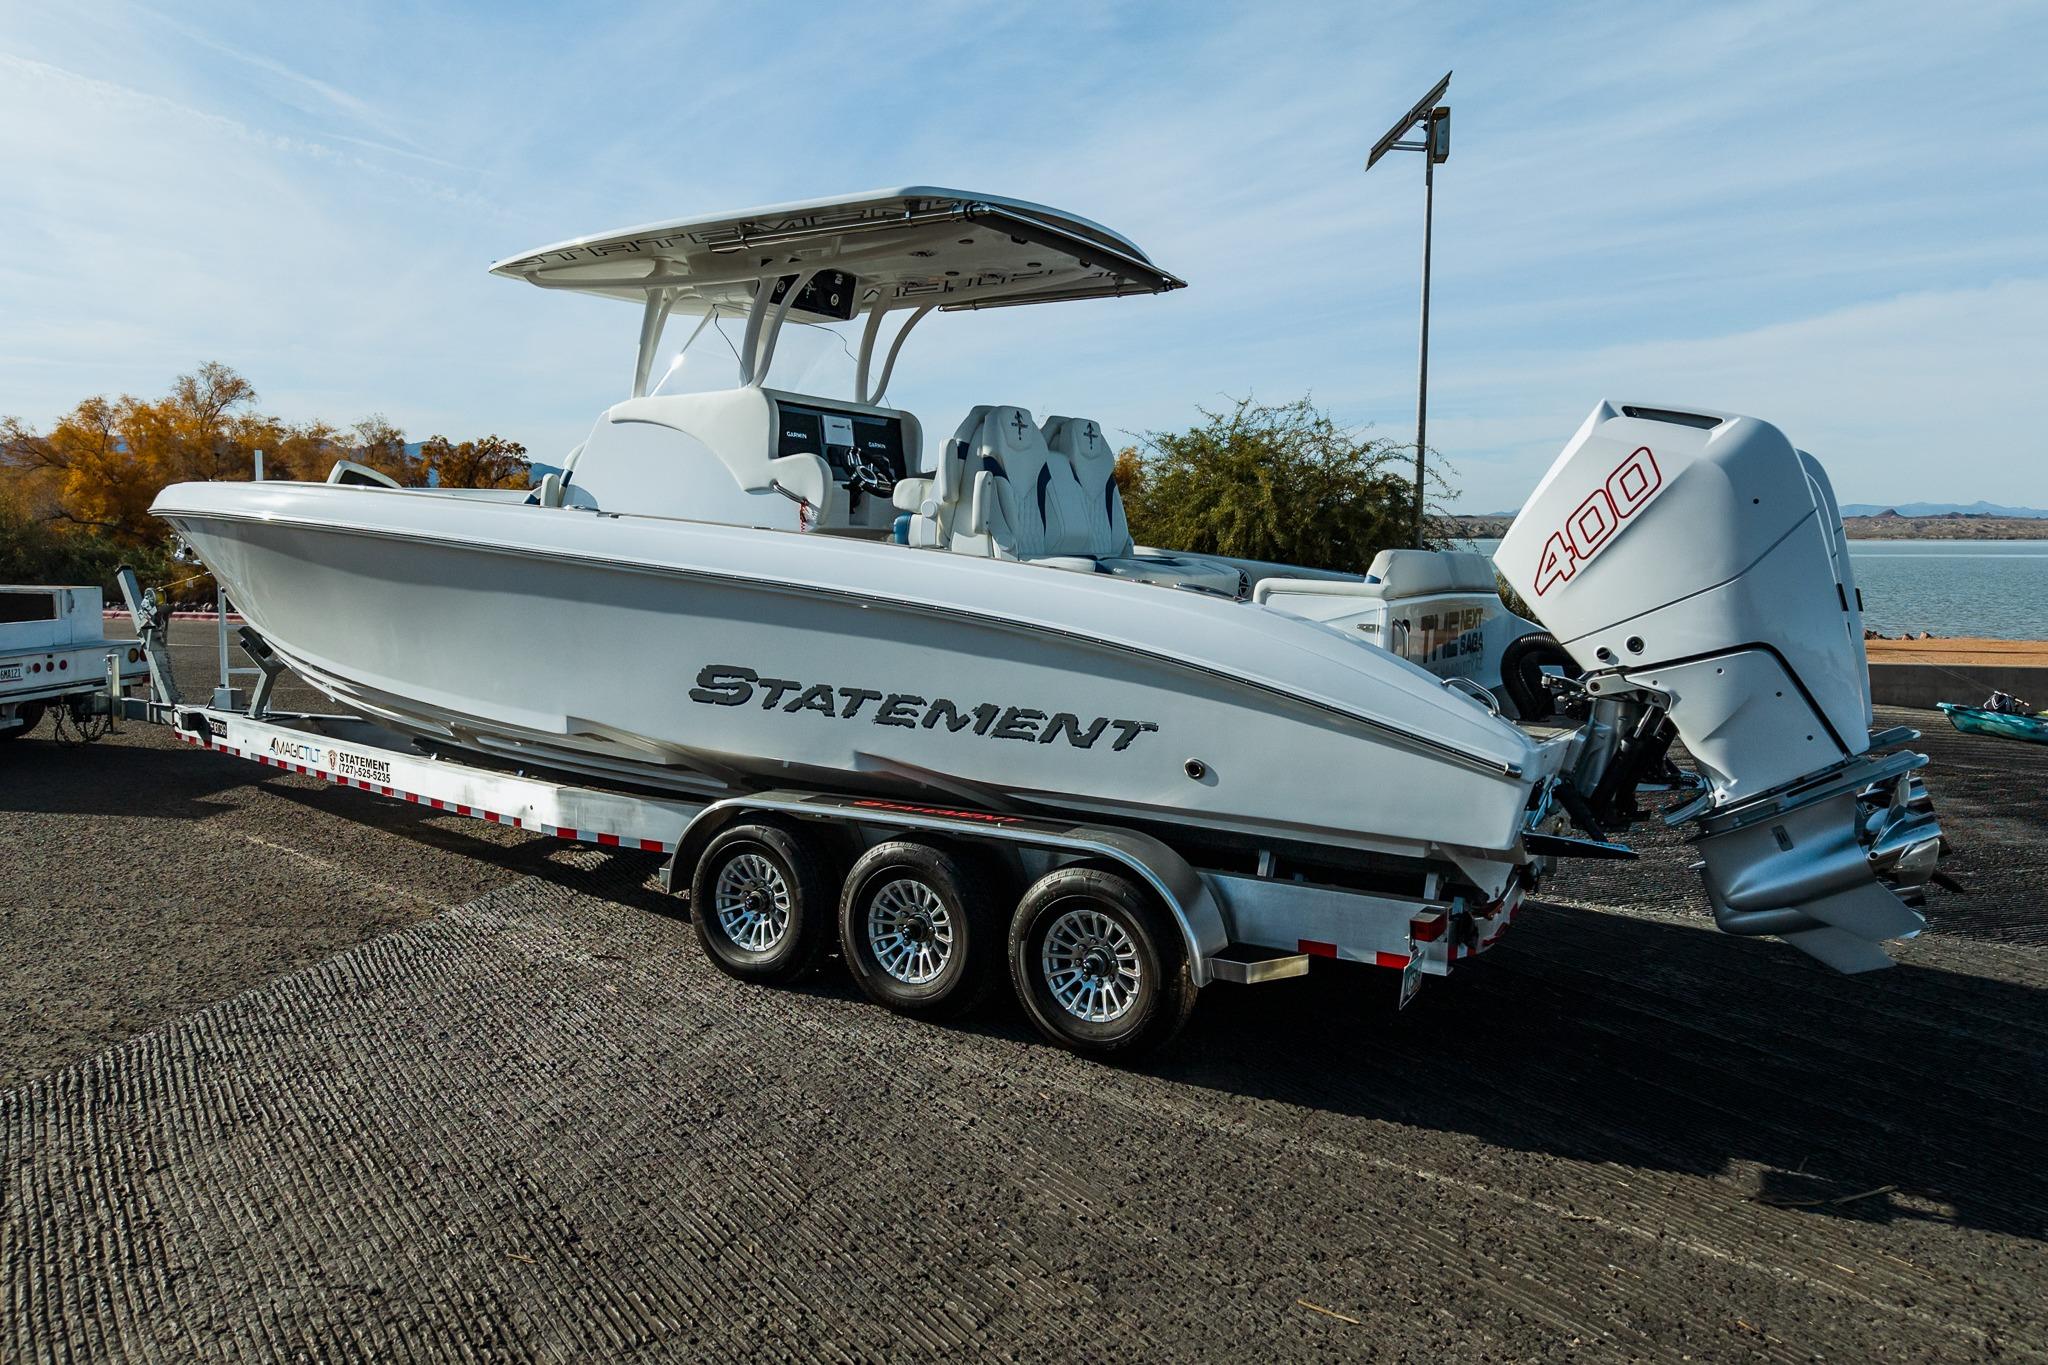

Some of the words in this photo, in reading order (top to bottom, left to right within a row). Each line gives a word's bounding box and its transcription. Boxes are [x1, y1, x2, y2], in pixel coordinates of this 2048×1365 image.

[786, 431, 807, 439] GARMIN
[868, 441, 886, 449] GARMIN
[1534, 446, 1662, 597] 400
[1461, 608, 1483, 630] NEXT
[689, 664, 1159, 751] STATEMENT
[339, 752, 390, 772] STATEMENT
[338, 763, 391, 783] (727)-525-5235
